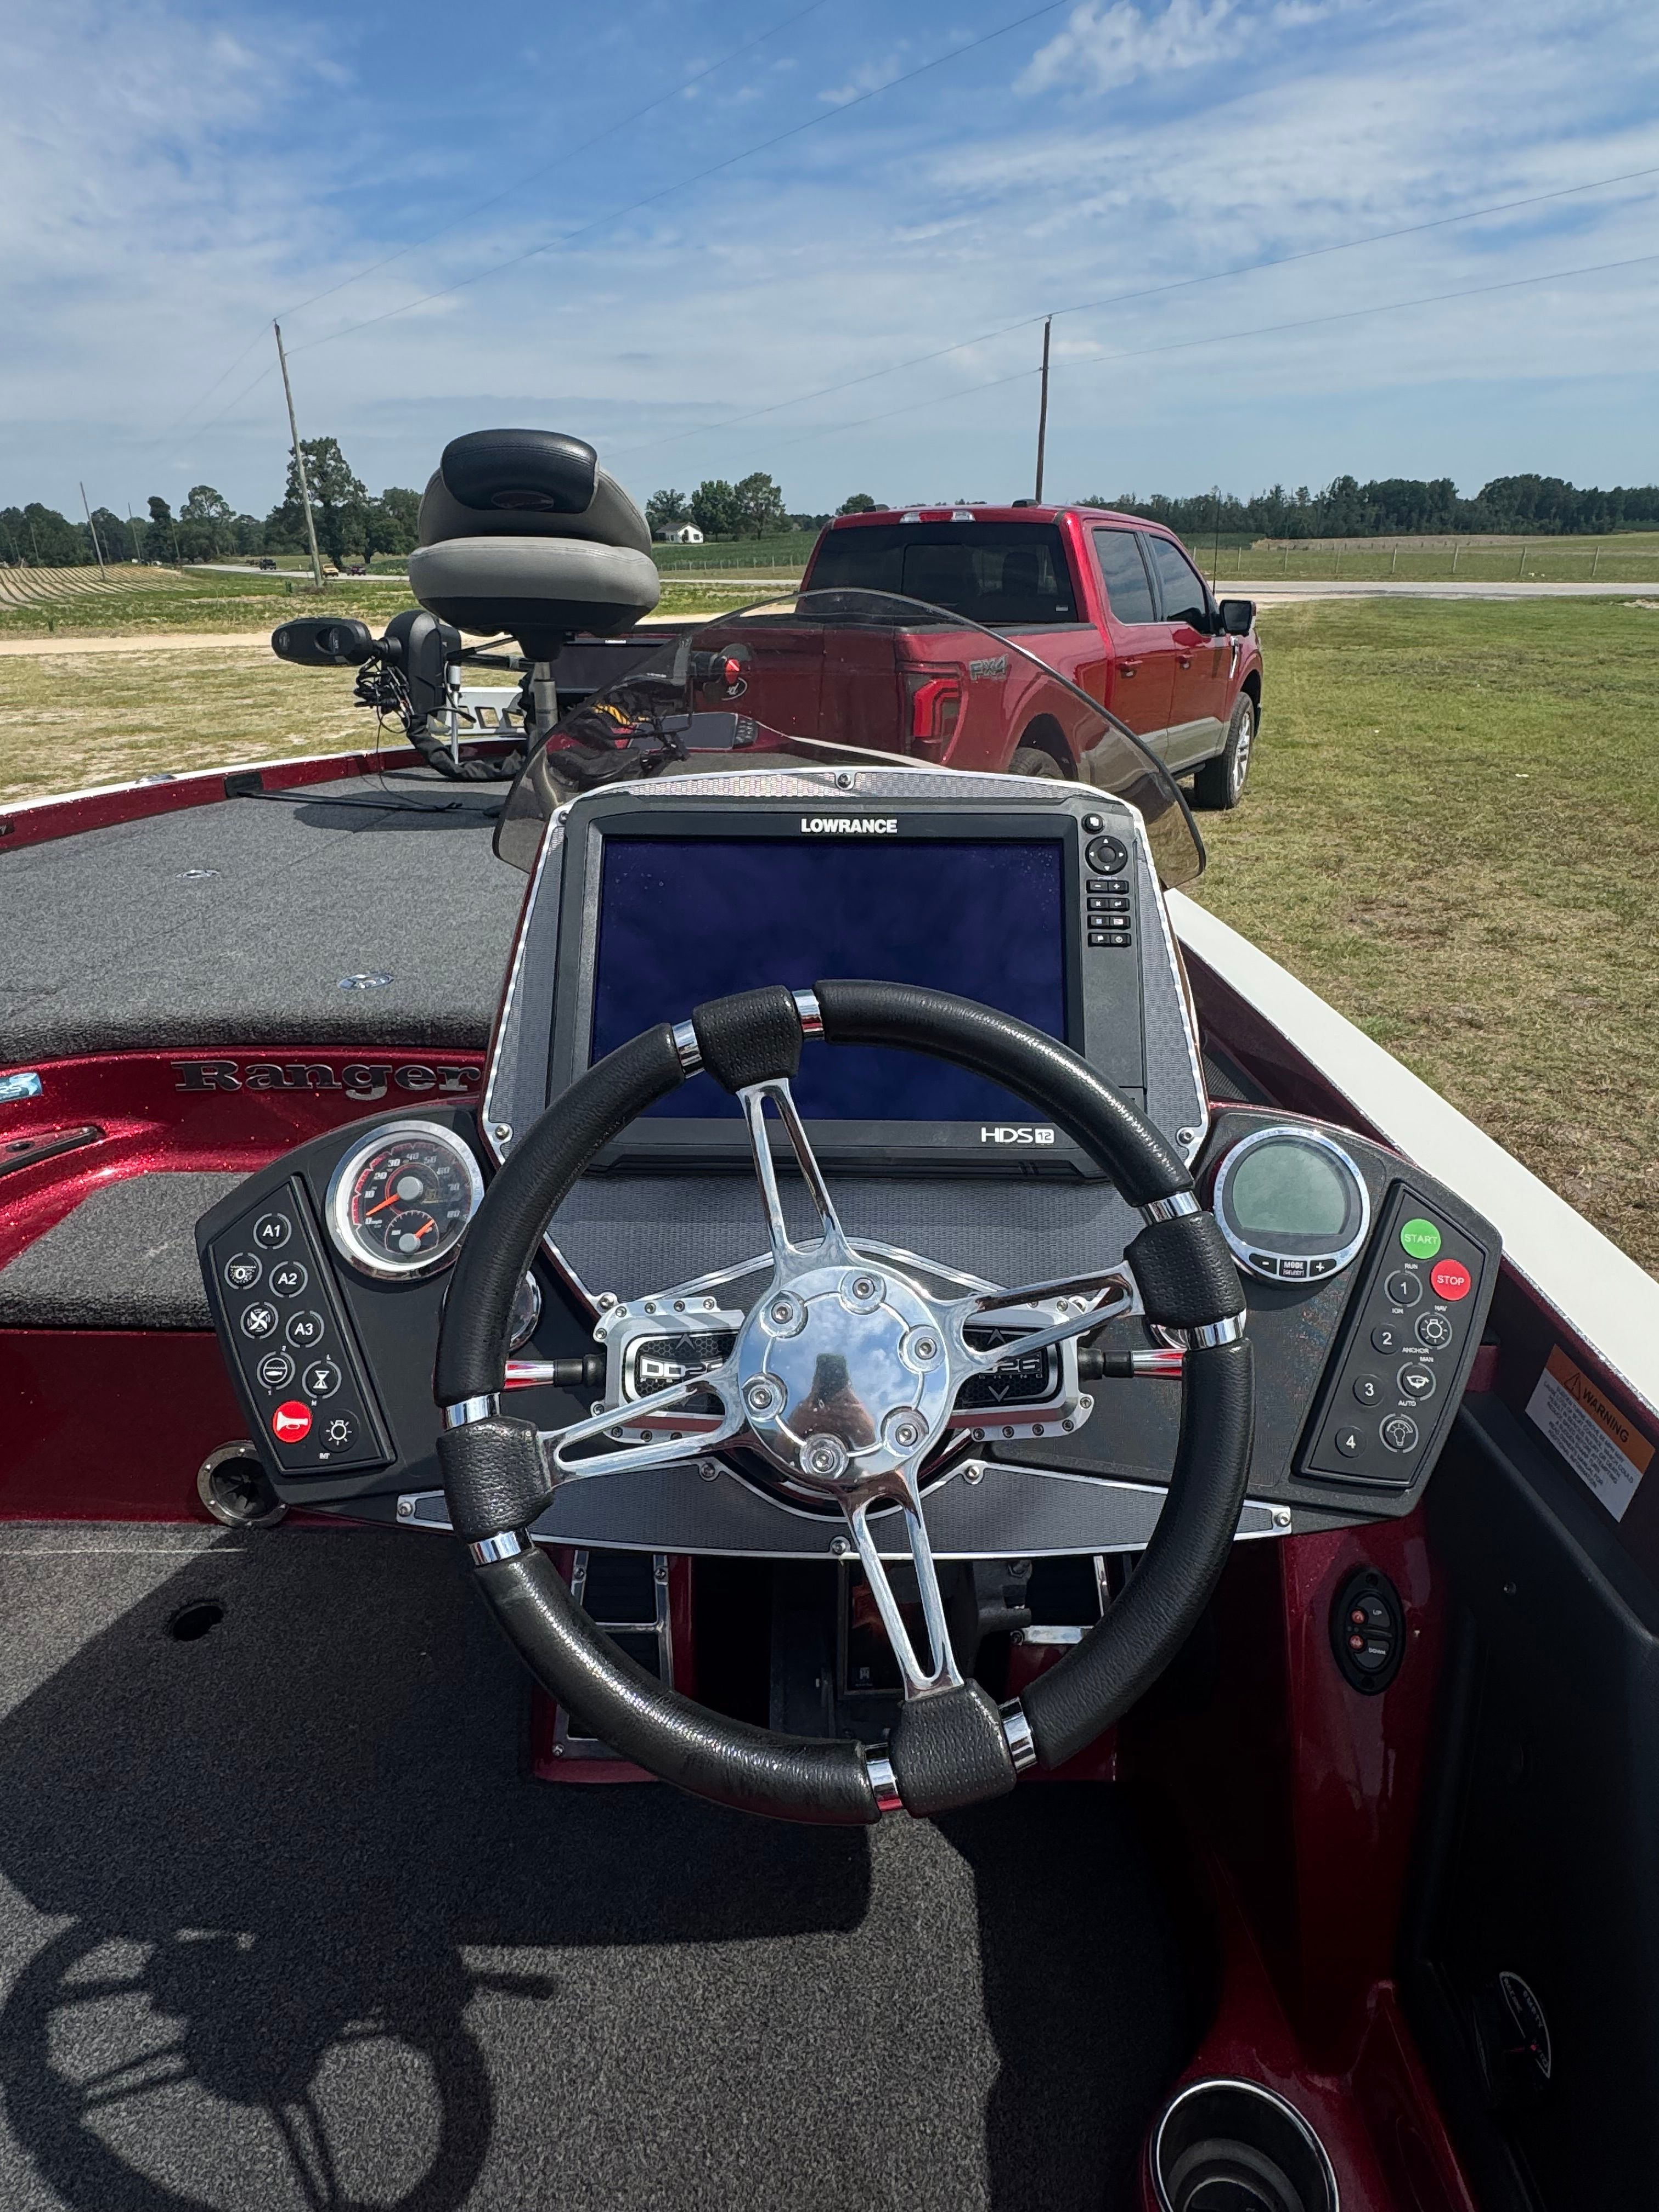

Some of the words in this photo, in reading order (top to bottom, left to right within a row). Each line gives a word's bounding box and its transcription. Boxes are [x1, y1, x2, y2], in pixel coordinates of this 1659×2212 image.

[969, 654, 1008, 681] FX4
[801, 819, 898, 833] LOWRANCE
[170, 1060, 482, 1101] Ranger
[981, 1127, 1034, 1143] HDS
[1036, 1131, 1053, 1142] 12
[387, 1159, 400, 1167] 30
[262, 1224, 280, 1237] A1
[1404, 1234, 1437, 1244] START
[278, 1273, 297, 1285] A2
[1437, 1275, 1465, 1285] STOP
[1401, 1282, 1407, 1295] 1
[294, 1323, 313, 1335] A3
[1382, 1332, 1392, 1345] 2
[1365, 1383, 1374, 1396] 3
[1583, 1387, 1629, 1443] WARNING
[1346, 1435, 1356, 1449] 4
